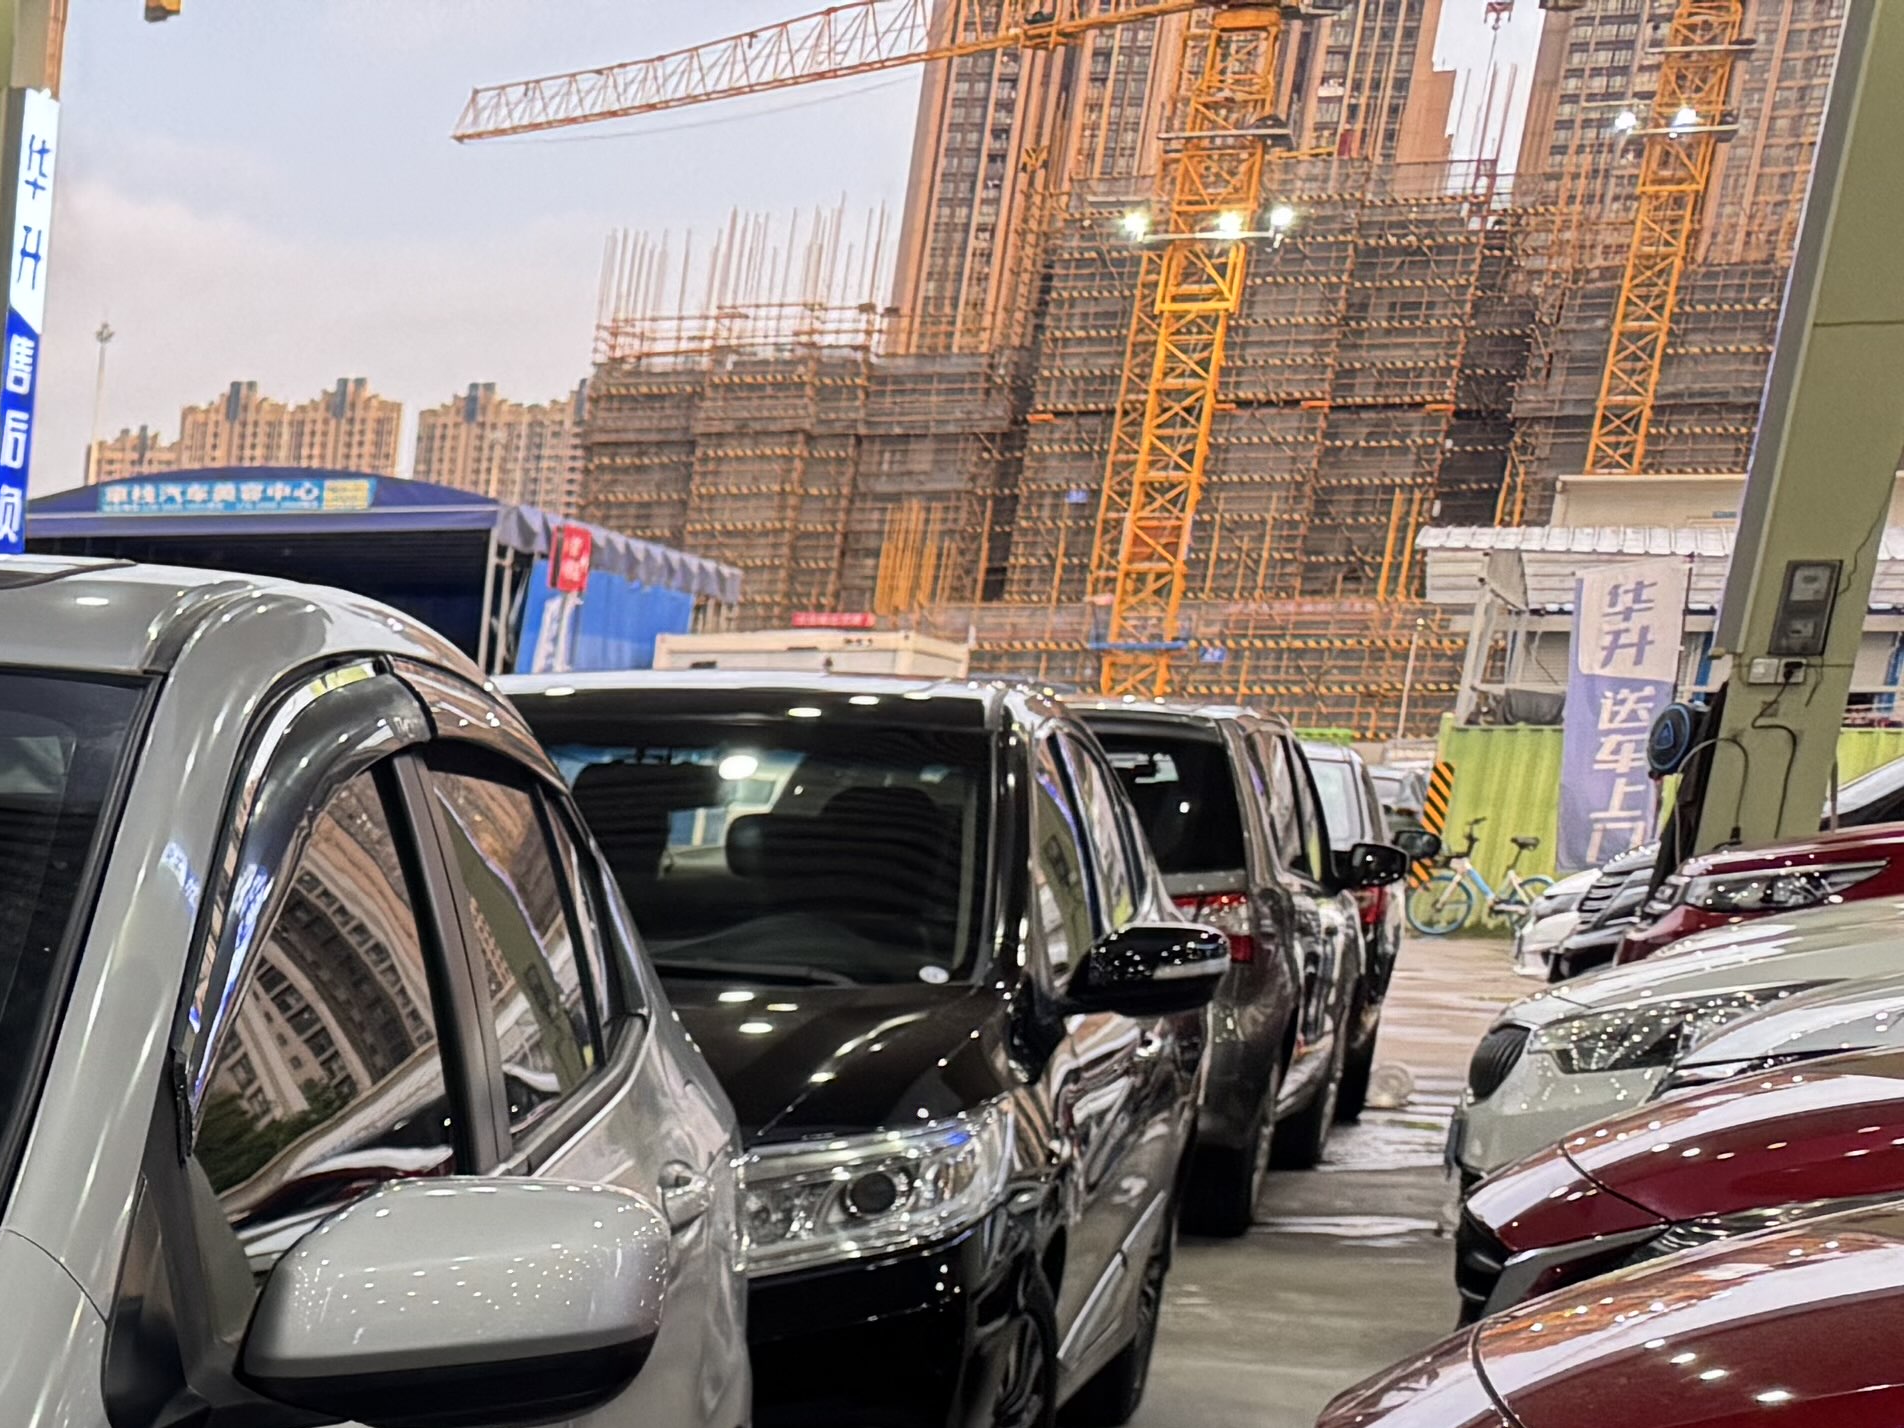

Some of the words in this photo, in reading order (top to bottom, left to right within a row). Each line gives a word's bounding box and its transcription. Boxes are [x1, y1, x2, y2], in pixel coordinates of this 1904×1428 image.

[16, 134, 52, 291] 华升
[1599, 579, 1658, 670] 华升
[1585, 685, 1657, 865] 送车上门
